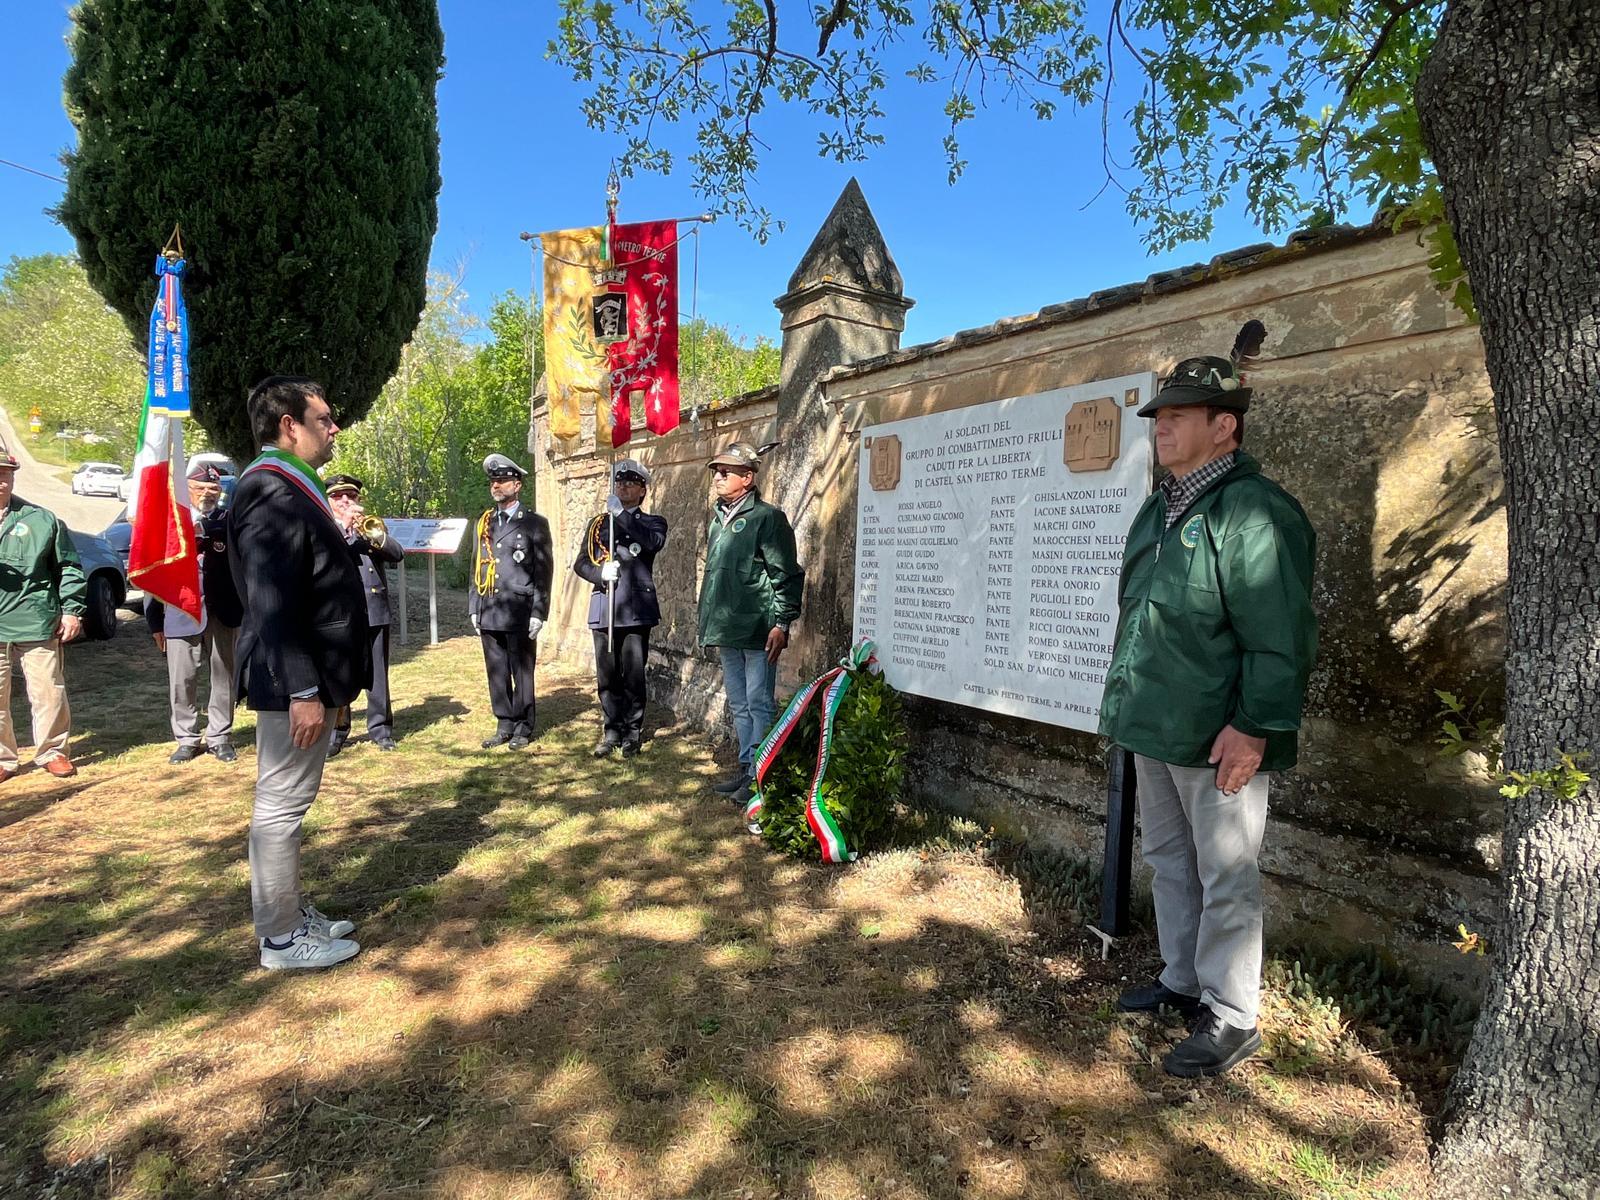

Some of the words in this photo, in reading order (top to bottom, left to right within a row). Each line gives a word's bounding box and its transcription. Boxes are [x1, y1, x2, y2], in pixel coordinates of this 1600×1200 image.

[944, 430, 952, 440] AI
[956, 424, 989, 438] SOLDATI
[994, 421, 1011, 431] DEL
[906, 448, 933, 460] GRUPPO
[937, 447, 947, 457] DI
[950, 435, 1024, 454] COMBATTIMENTO
[1028, 429, 1062, 444] FRIULI
[926, 461, 955, 472] CADUTI
[958, 458, 973, 469] PER
[977, 456, 989, 466] LA
[915, 479, 922, 488] DI
[925, 476, 953, 487] CASTEL
[957, 475, 973, 484] SAN
[976, 471, 1007, 483] PIETRO
[1012, 467, 1046, 479] TERME
[991, 496, 1016, 505] FANTE
[1035, 490, 1096, 503] GHISLANZONI
[1100, 488, 1127, 498] LUIGI
[898, 502, 914, 510] ROSSI
[916, 500, 942, 509] ANGELO
[991, 509, 1015, 518] FANTE
[1034, 507, 1066, 516] IACONE
[1070, 504, 1121, 515] SALVATORE
[898, 513, 931, 522] CUSUMANO
[933, 512, 964, 520] GIACOMO
[897, 526, 927, 534] MASIELLO
[990, 523, 1014, 532] FANTE
[1034, 522, 1068, 531] MARCHI
[1072, 520, 1095, 530] GINO
[897, 538, 917, 546] MASINI
[920, 538, 958, 546] GUGLIELMO
[990, 537, 1013, 545] FANTE
[1033, 536, 1090, 545] MAROCCHESI
[1095, 535, 1128, 544] NELLO
[915, 550, 935, 558] GUIDO
[989, 551, 1013, 559] FANTE
[1032, 551, 1062, 559] MASINI
[1066, 550, 1124, 560] GUGLIELMO
[988, 564, 1012, 573] FANTE
[1032, 564, 1067, 574] ODDONE
[1072, 566, 1122, 576] FRANCESC
[896, 574, 920, 582] SOLAZZI
[922, 575, 943, 583] MARIO
[988, 578, 1012, 586] FANTE
[1031, 579, 1059, 589] PERRA
[1064, 580, 1100, 590] ONORIO
[861, 583, 877, 591] FANTE
[895, 586, 915, 594] ARENA
[917, 587, 954, 596] FRANCESCO
[860, 595, 877, 603] FANTE
[895, 597, 919, 606] BARTOLI
[922, 600, 951, 609] ROBERTO
[987, 591, 1011, 600] FANTE
[1030, 593, 1070, 604] PUGLIOLI
[1075, 596, 1094, 606] EDO
[860, 606, 876, 614] FANTE
[894, 610, 932, 620] BRESCIANINI
[935, 613, 975, 624] FRANCESCO
[987, 605, 1010, 614] FANTE
[1030, 608, 1072, 620] REGGIOLI
[1075, 612, 1110, 623] SERGIO
[860, 617, 876, 625] FANTE
[894, 621, 923, 631] CASTAGNA
[926, 624, 960, 636] SALVATORE
[986, 618, 1010, 628] FANTE
[1029, 622, 1052, 632] RICCI
[1056, 625, 1099, 637] GIOVANNI
[859, 628, 875, 637] FANTE
[893, 633, 919, 643] CIUFFINI
[921, 637, 949, 647] AURELIO
[986, 631, 1009, 641] FANTE
[1028, 636, 1059, 647] ROMEO
[1063, 640, 1114, 654] SALVATORE
[893, 645, 920, 656] CUTTIGNI
[923, 649, 945, 659] EGIDIO
[985, 644, 1008, 655] FANTE
[1028, 650, 1070, 664] VERONESI
[1075, 656, 1111, 669] UMBER
[892, 656, 914, 665] FASANO
[917, 660, 946, 672] GIUSEPPE
[1028, 664, 1065, 678] D'AMICO
[1069, 672, 1105, 684] MICHEL
[964, 683, 985, 694] CASTEL
[987, 688, 999, 696] SAN
[1001, 690, 1024, 701] PIETRO
[1065, 703, 1091, 714] APRILE
